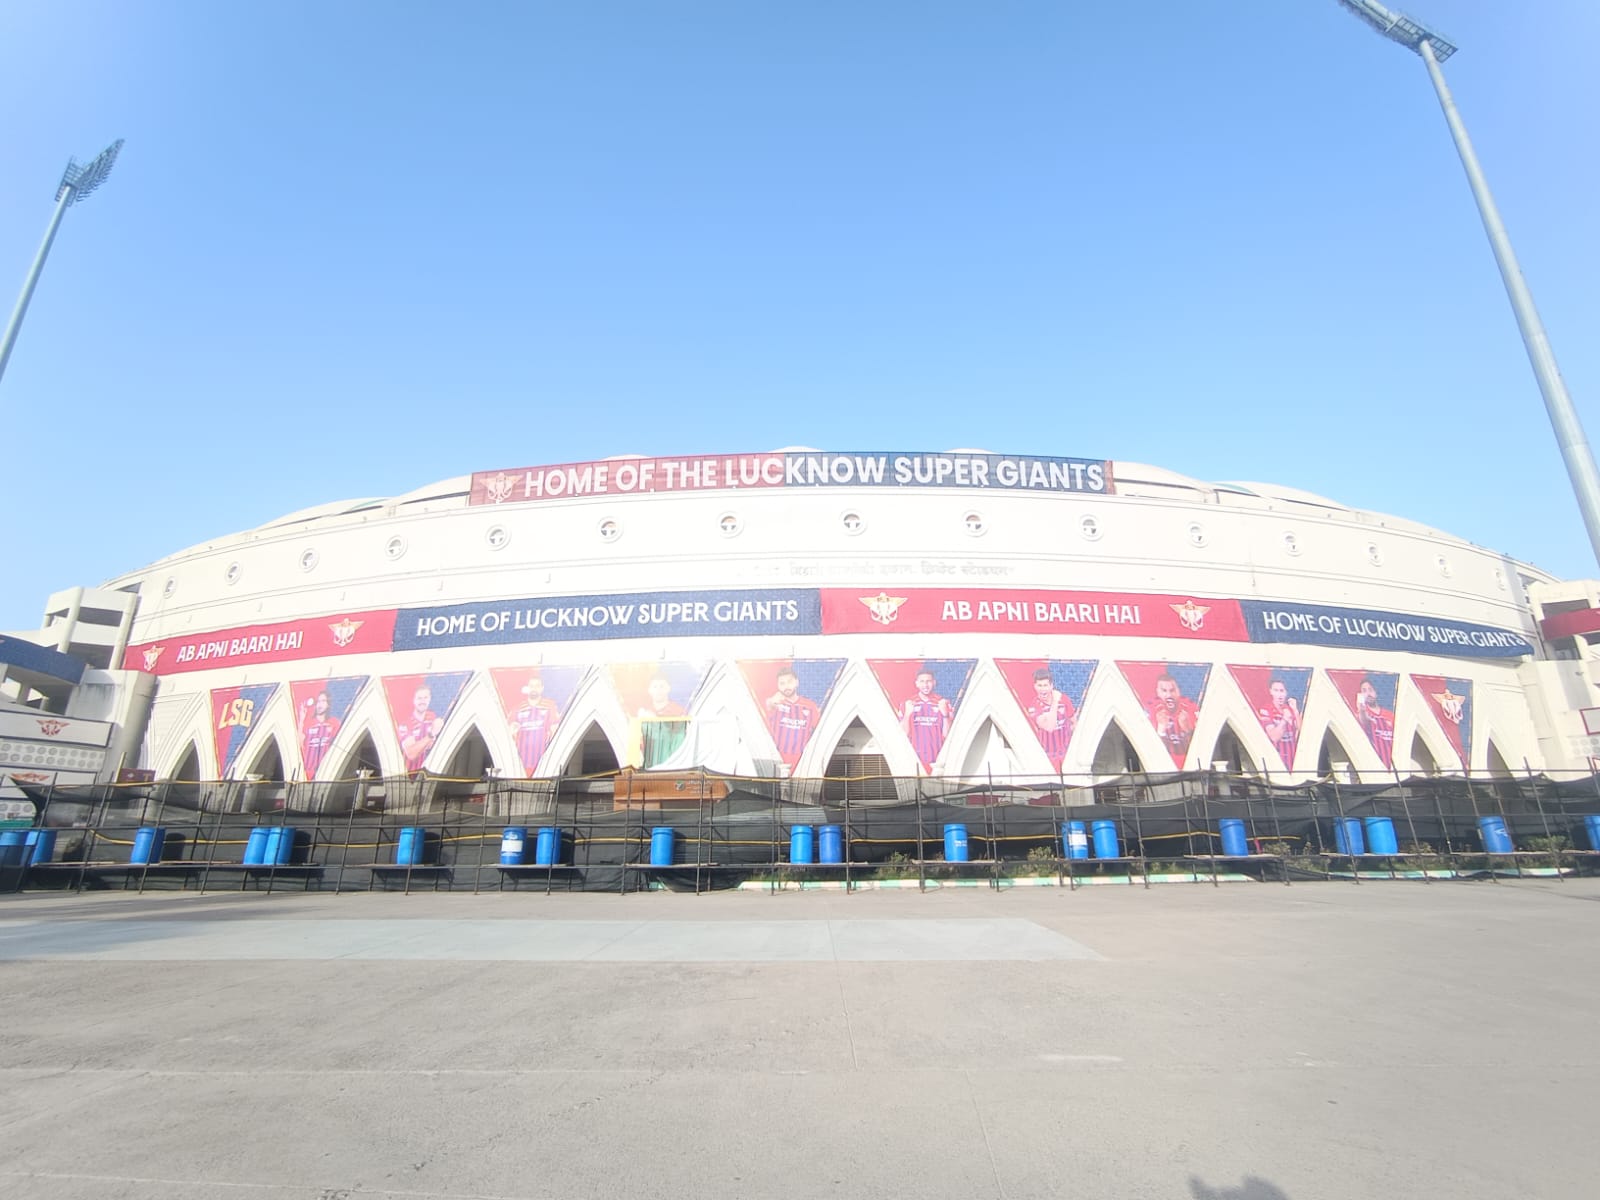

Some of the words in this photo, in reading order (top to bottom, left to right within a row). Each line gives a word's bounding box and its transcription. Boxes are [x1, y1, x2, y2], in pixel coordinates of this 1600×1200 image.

[524, 465, 608, 497] HOME
[615, 463, 656, 491] OF
[662, 460, 717, 489] THE
[725, 456, 886, 486] LUCKNOW
[894, 457, 990, 487] SUPER
[996, 461, 1104, 491] GIANTS
[416, 614, 477, 637] HOME
[480, 611, 511, 632] OF
[514, 605, 634, 630] LUCKNOW
[637, 602, 709, 623] SUPER
[713, 600, 799, 622] GIANTS
[941, 600, 973, 621] AB
[977, 601, 1029, 622] APNI
[1034, 602, 1100, 623] BAARI
[1104, 604, 1142, 624] HAI
[1262, 611, 1319, 632] HOME
[1319, 615, 1342, 634] OF
[1346, 618, 1426, 641] LUCKNOW
[1427, 626, 1475, 645] SUPER
[1471, 631, 1525, 647] GIANTS
[176, 645, 195, 663] AB
[196, 640, 229, 660] APNI
[230, 634, 274, 655] BAARI
[276, 631, 304, 649] HAI
[218, 698, 254, 729] LSG
